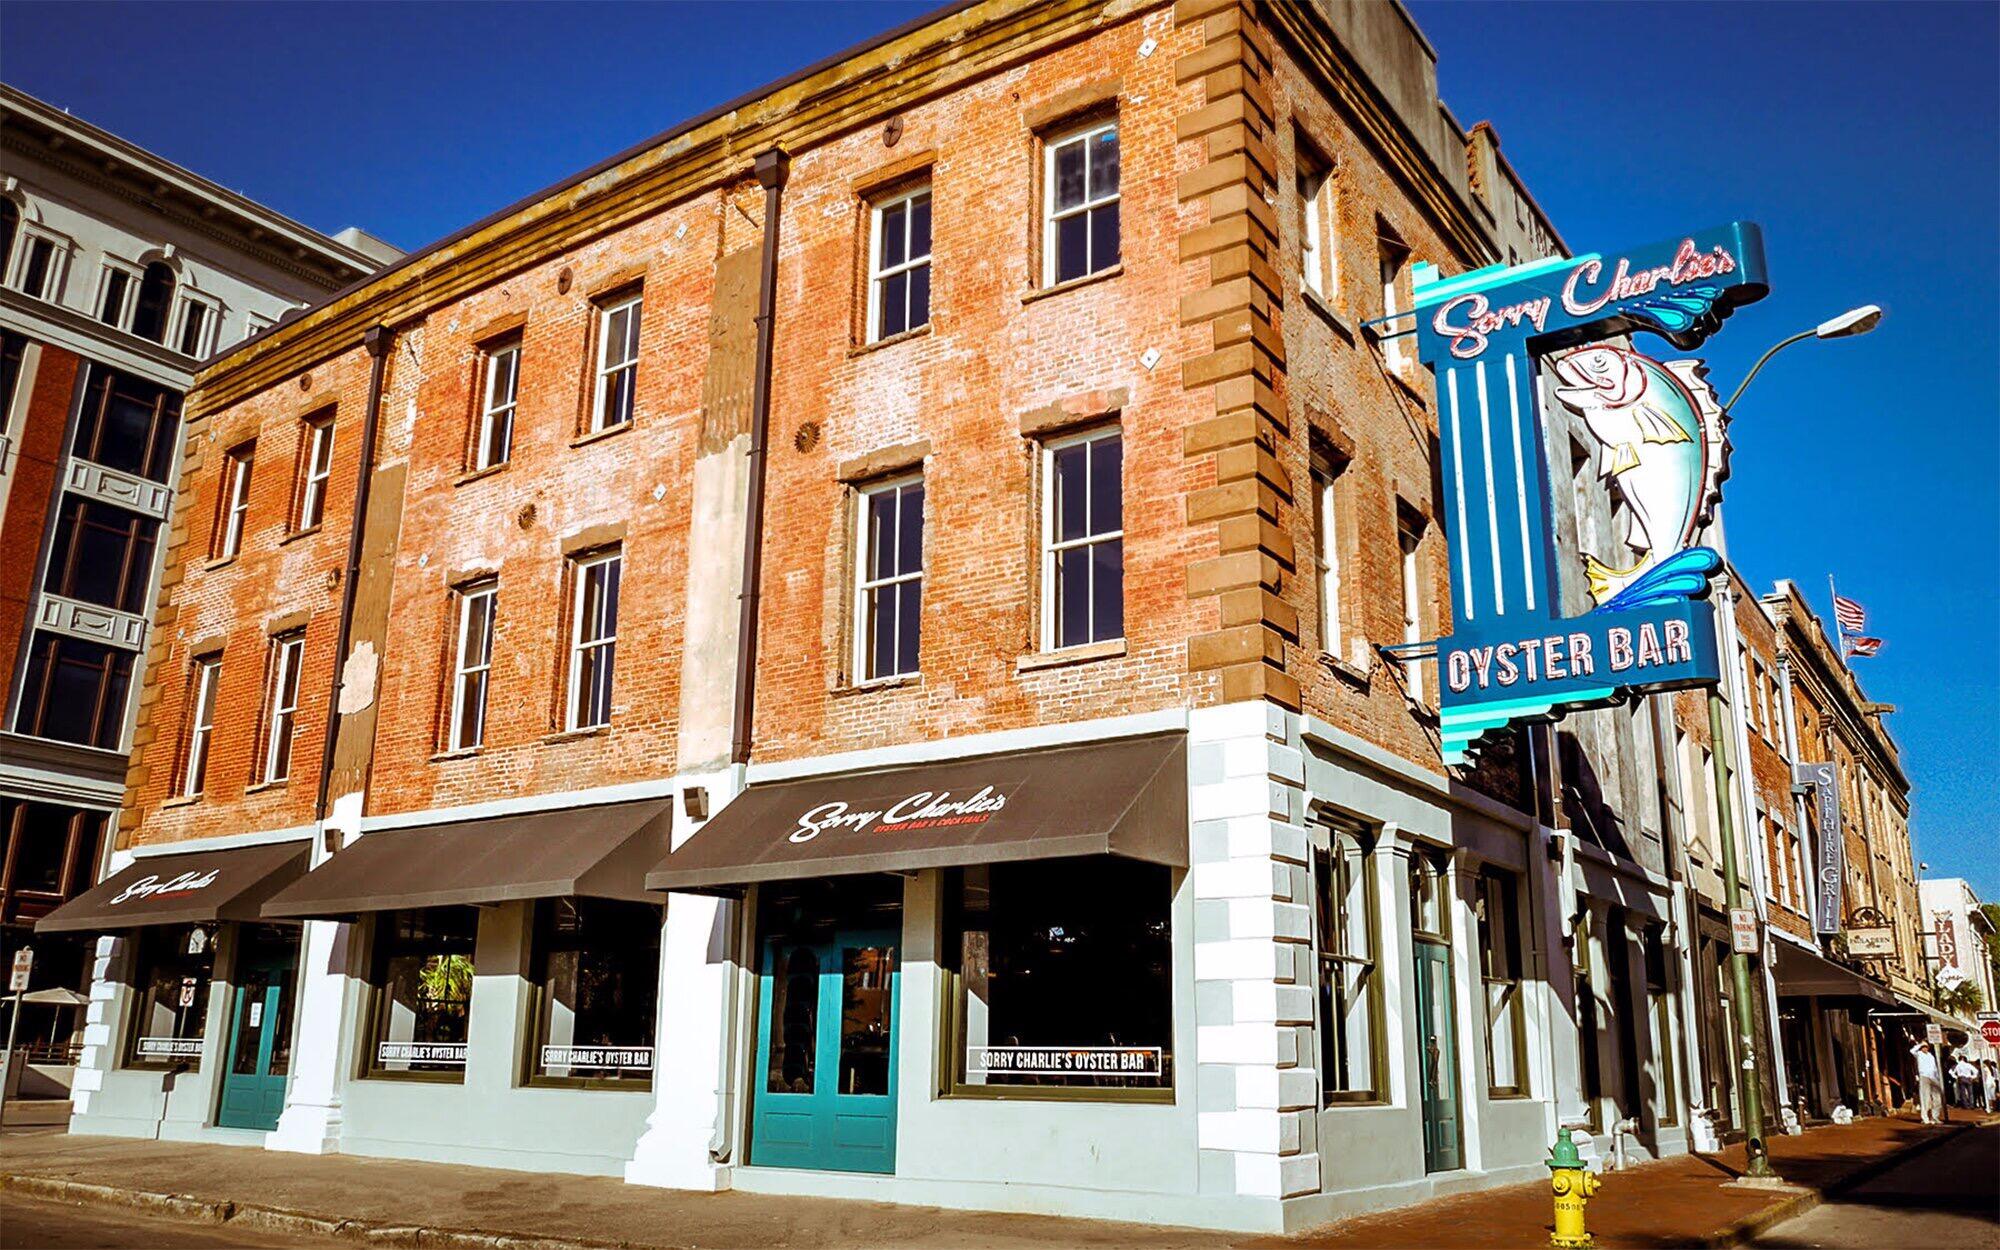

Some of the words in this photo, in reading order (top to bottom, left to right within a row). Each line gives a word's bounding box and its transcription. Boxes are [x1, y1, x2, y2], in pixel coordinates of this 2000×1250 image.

[1433, 293, 1551, 358] Sorry
[1561, 237, 1737, 316] Charlie's
[1449, 632, 1594, 692] OYSTER
[1608, 619, 1692, 672] BAR
[788, 801, 882, 843] Sorry
[883, 785, 1007, 824] Charlie's
[1821, 867, 1838, 930] GRILL
[545, 1049, 568, 1063] SORRY
[568, 1050, 603, 1064] CHARLIE'S
[605, 1051, 633, 1065] OYSTER
[634, 1051, 650, 1065] BAR
[979, 1051, 1014, 1068] SORRY
[1016, 1051, 1073, 1069] CHARLIE'S
[1075, 1052, 1118, 1070] OYSTER
[1120, 1053, 1144, 1070] BAR
